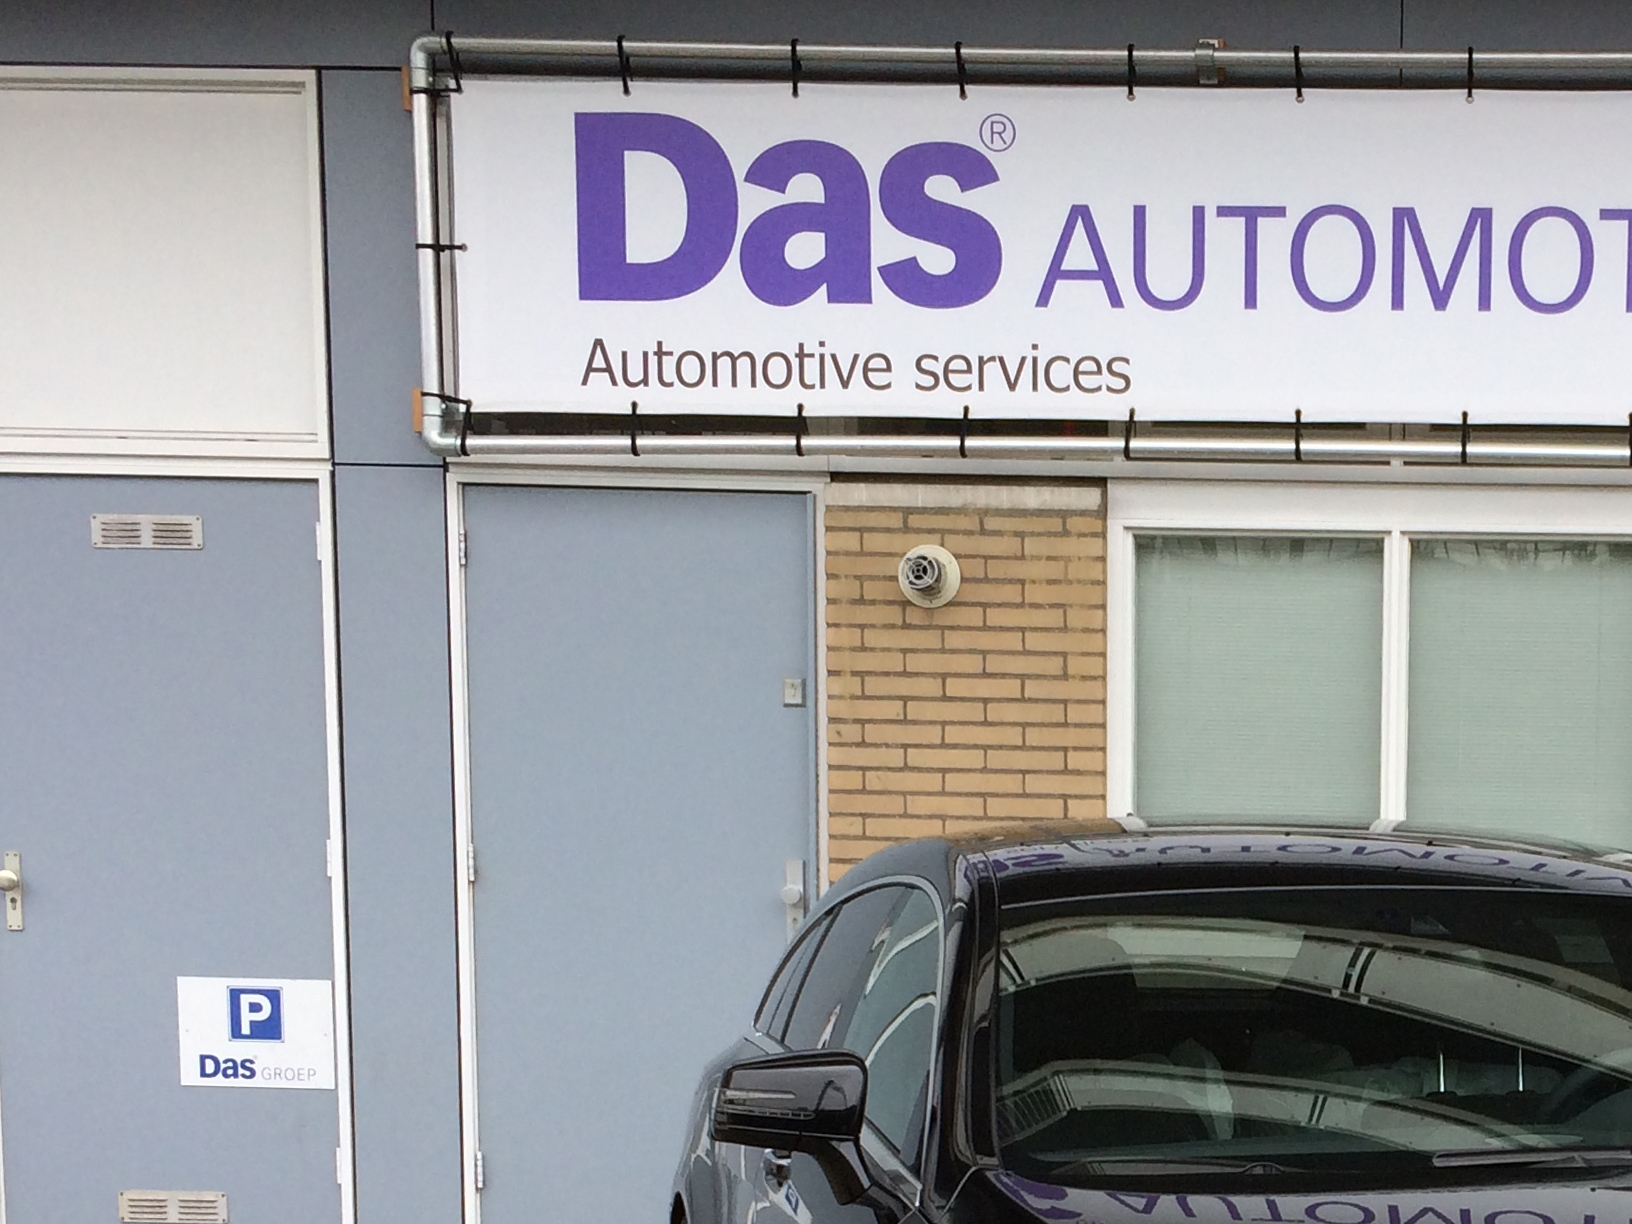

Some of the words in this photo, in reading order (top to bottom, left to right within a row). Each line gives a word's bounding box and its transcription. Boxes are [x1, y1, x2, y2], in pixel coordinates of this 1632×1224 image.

[581, 338, 892, 392] Automotive
[914, 344, 1132, 394] services
[239, 993, 272, 1035] P
[199, 1054, 256, 1080] Das
[261, 1067, 317, 1082] GROEP
